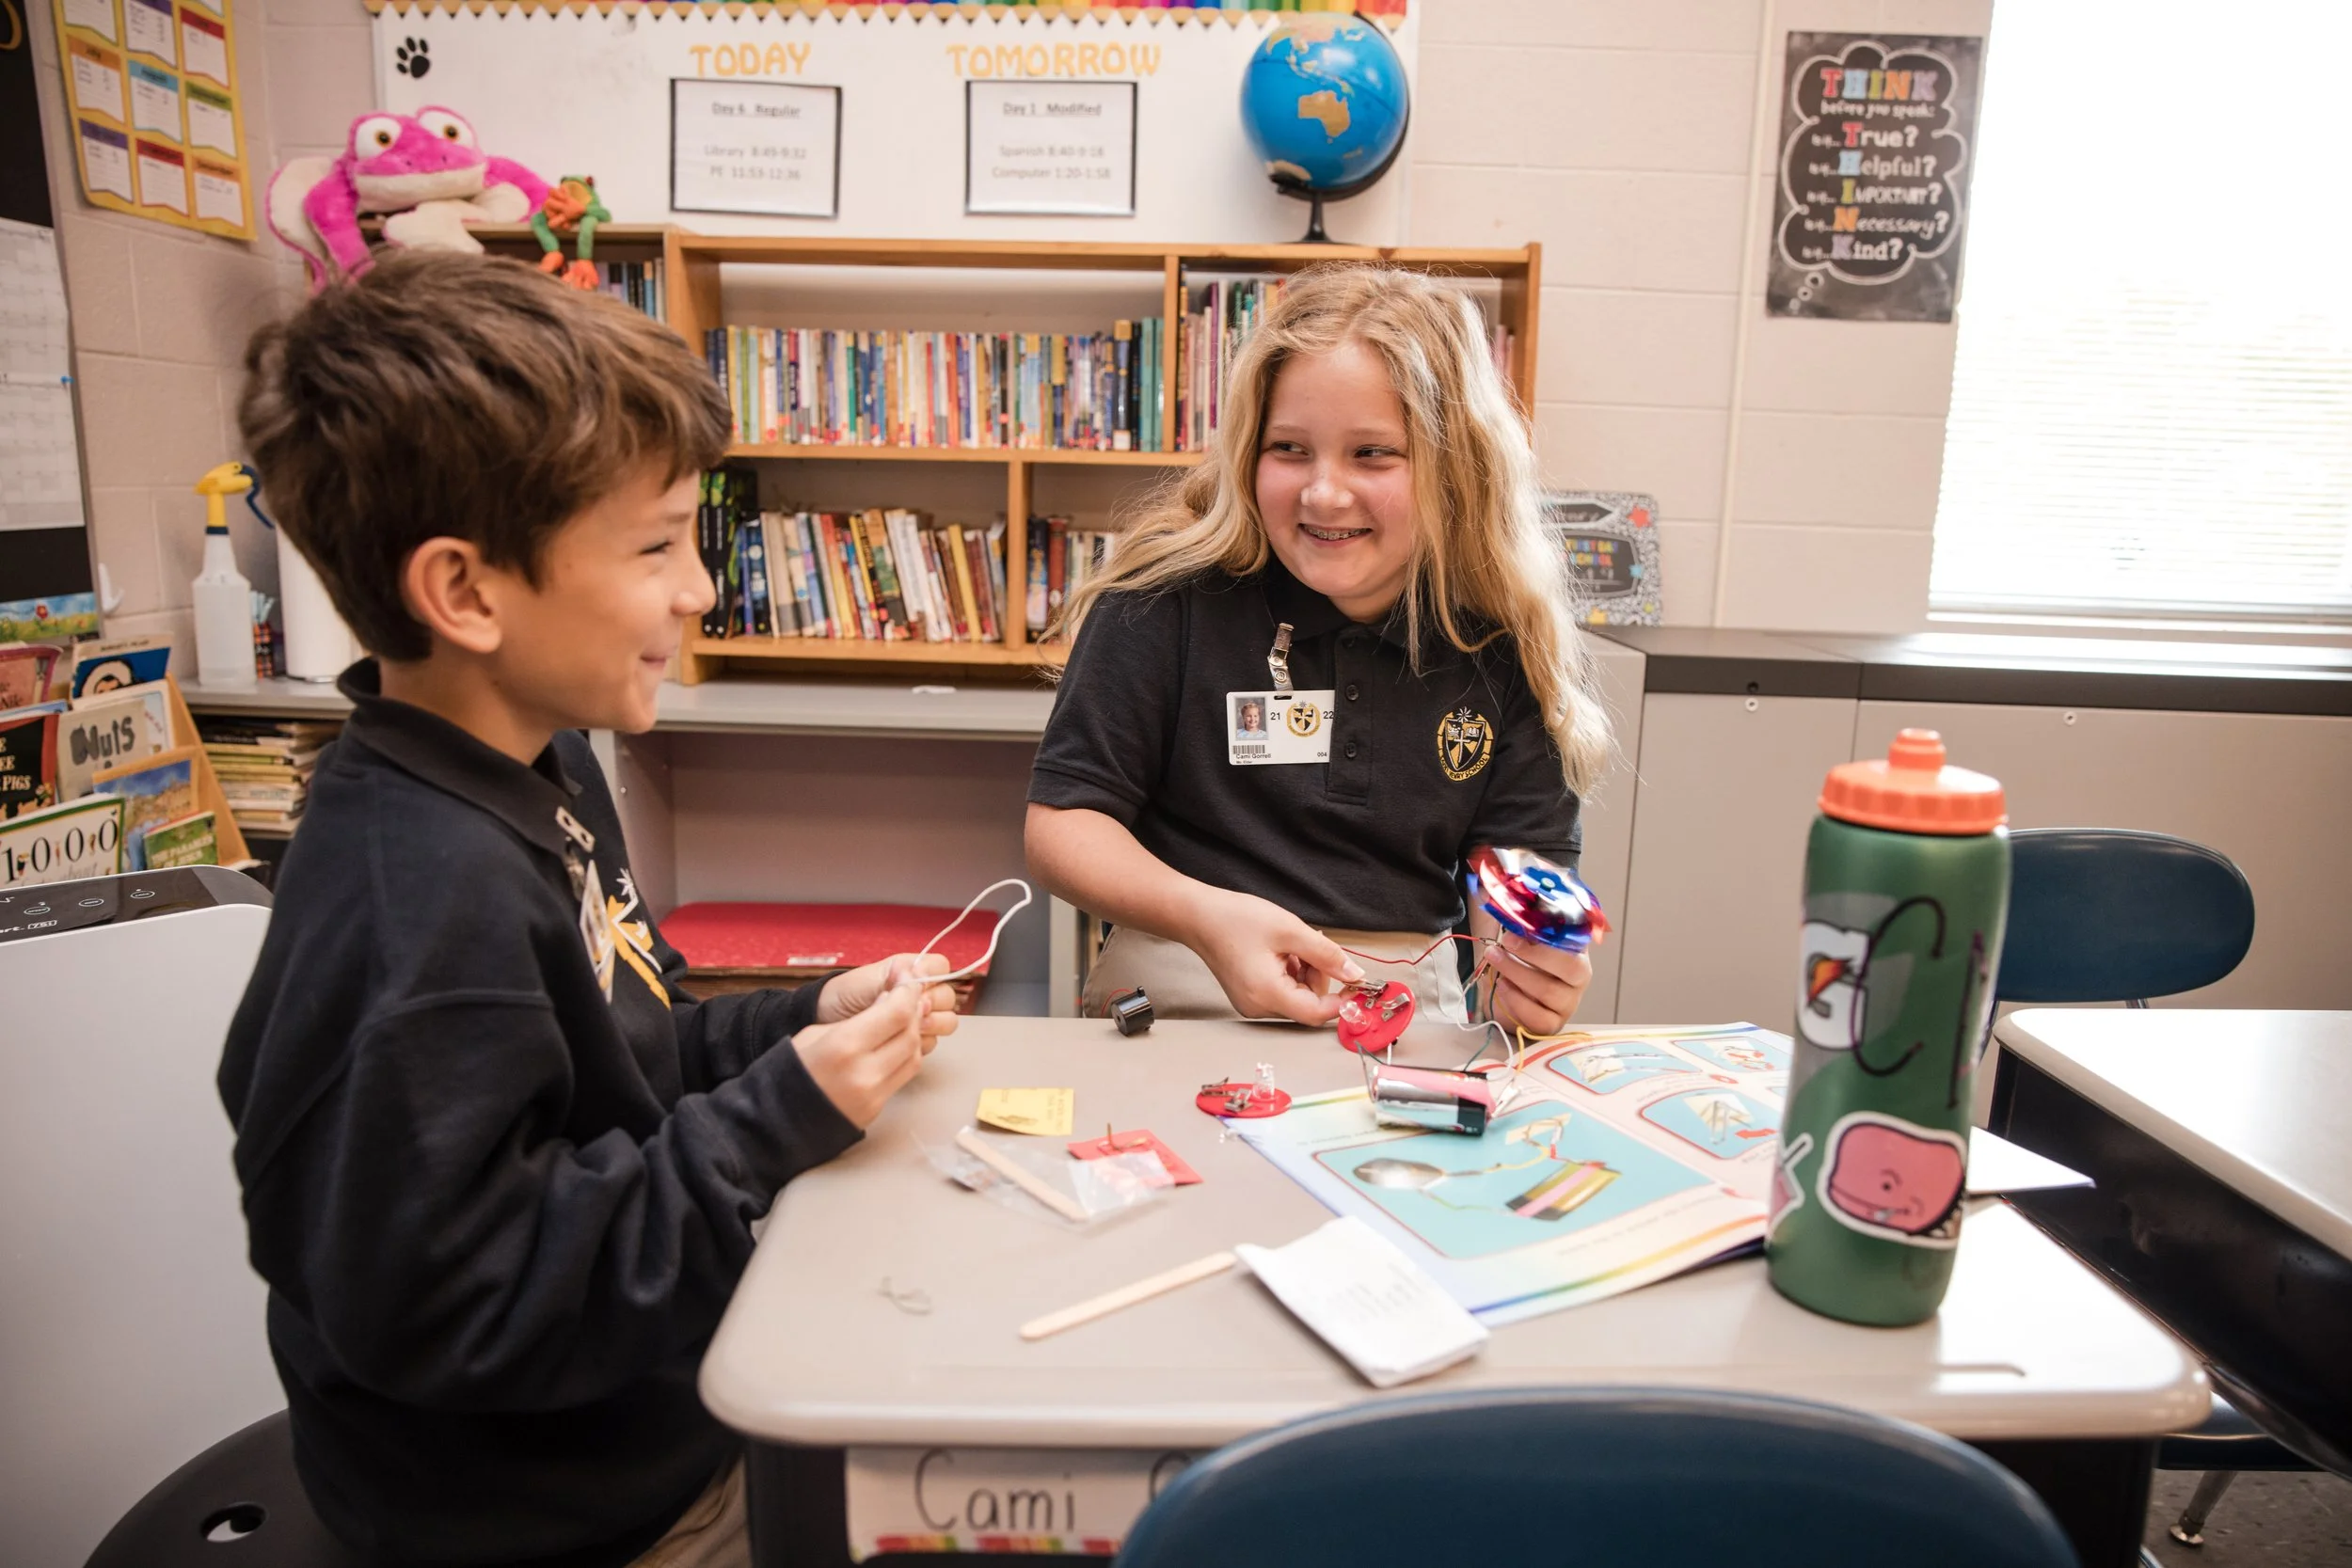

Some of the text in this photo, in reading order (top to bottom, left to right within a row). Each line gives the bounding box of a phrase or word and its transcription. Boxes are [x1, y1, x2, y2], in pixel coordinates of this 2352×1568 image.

[688, 41, 811, 79] TODAY
[946, 41, 1161, 77] TOMORROW
[1820, 68, 1938, 101] THINK
[711, 101, 734, 116] Day
[755, 103, 802, 119] Regular
[1003, 103, 1025, 117] Day
[1047, 103, 1102, 117] Modified
[1820, 100, 1865, 114] before
[1866, 103, 1890, 119] you
[1842, 121, 1918, 148] True?
[705, 145, 744, 158] Library
[999, 146, 1044, 159] Spanish
[993, 166, 1051, 181] Computer
[1837, 151, 1937, 181] Helpful?
[1834, 207, 1949, 240] Necessary?
[1832, 234, 1903, 260] Kind?
[1270, 711, 1334, 721] 21 22
[1465, 757, 1488, 778] SCHOOL
[3, 775, 31, 791] PIGS
[914, 1448, 1075, 1532] Cami
